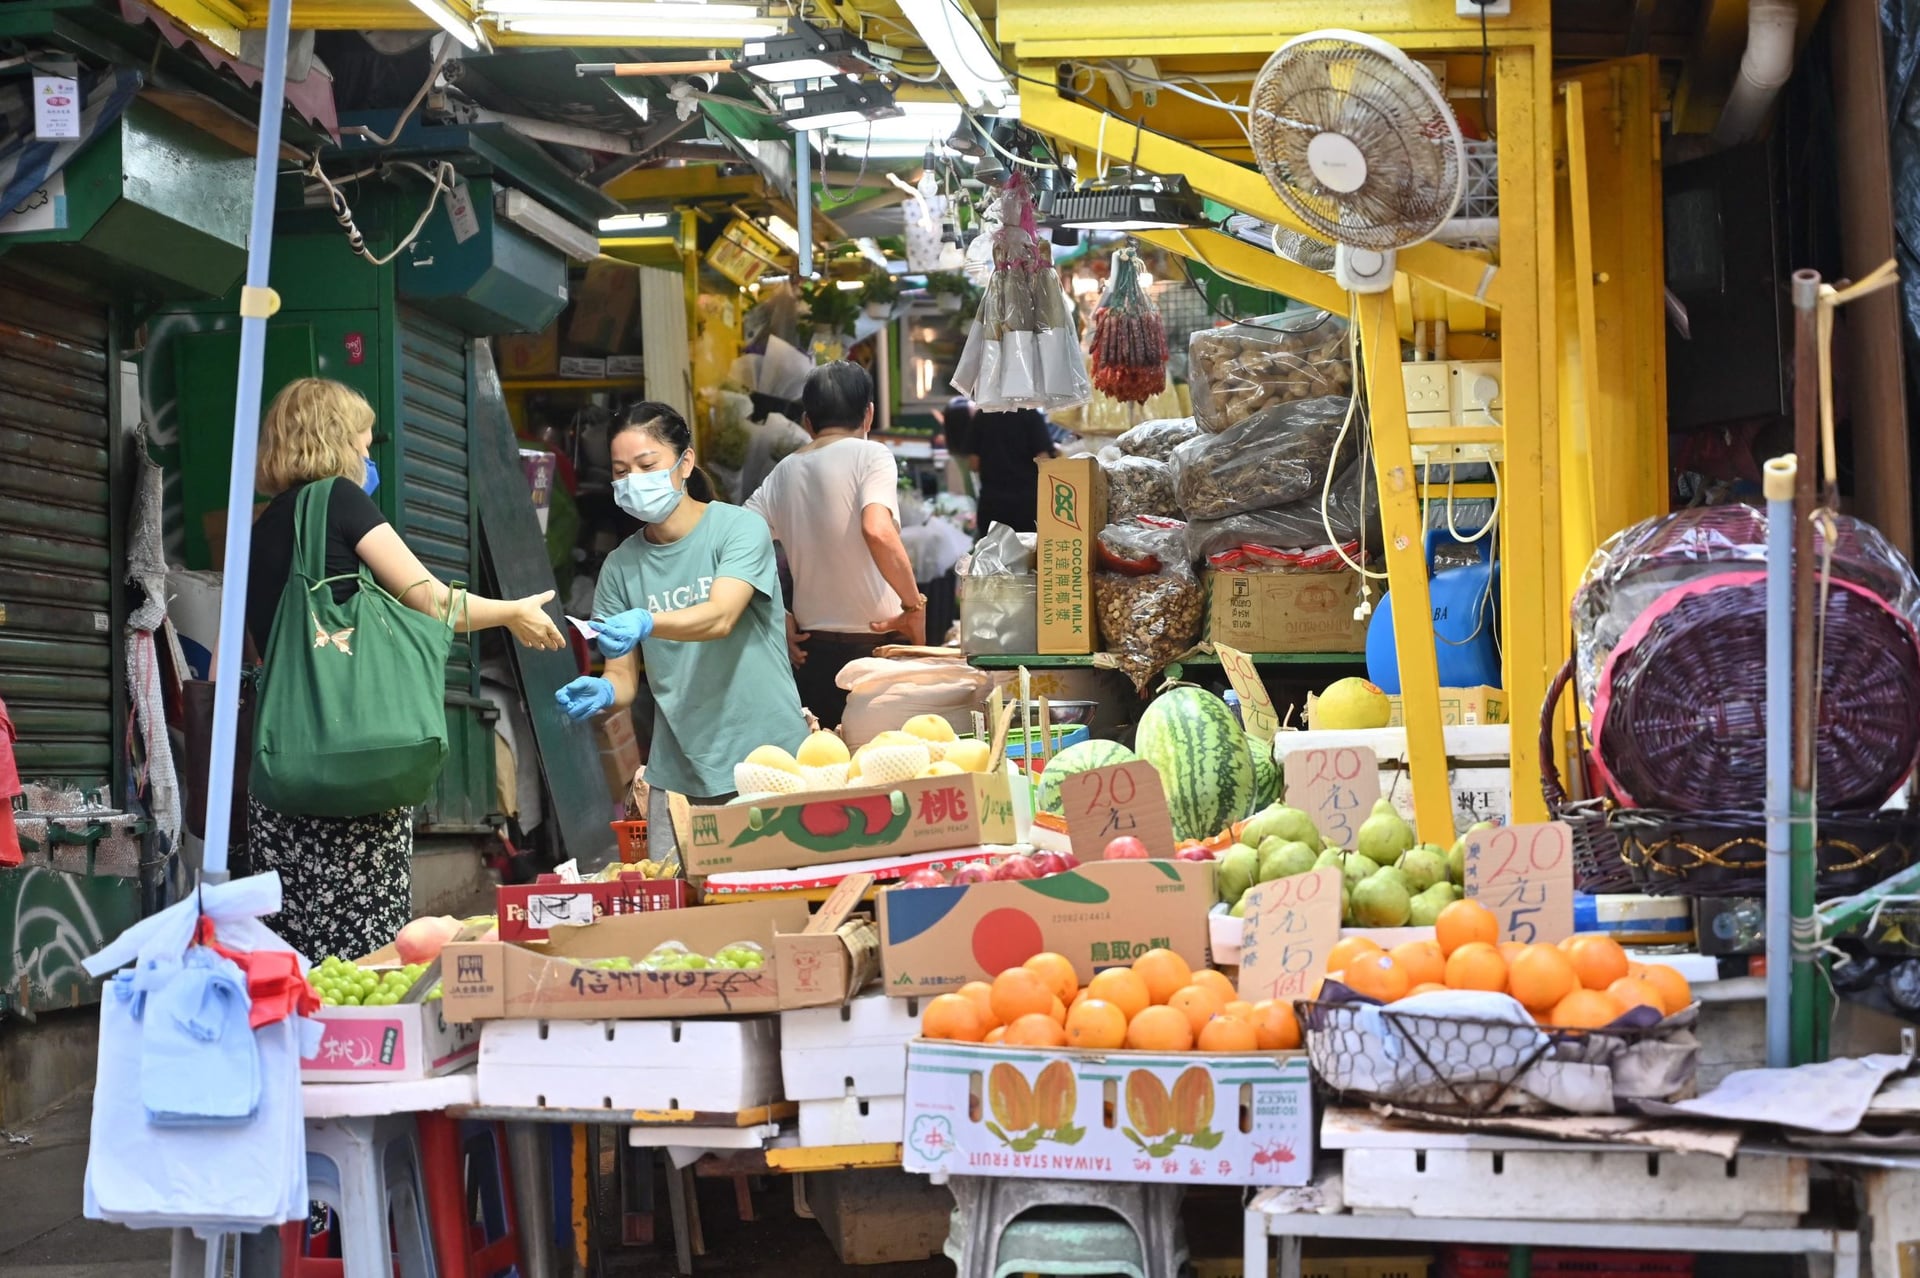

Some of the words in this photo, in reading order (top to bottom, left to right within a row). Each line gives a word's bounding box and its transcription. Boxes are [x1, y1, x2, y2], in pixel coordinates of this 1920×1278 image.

[1043, 538, 1053, 565] MADE
[1043, 567, 1053, 577] IN
[1072, 538, 1082, 600] COCONUT
[1043, 578, 1053, 626] THAILAND
[1072, 603, 1082, 634] MILK
[1305, 748, 1362, 787] 20
[917, 786, 969, 825] 桃
[1081, 766, 1136, 815] 20
[1318, 783, 1360, 811] 元
[1099, 806, 1137, 838] 元
[1326, 812, 1353, 847] 3
[1487, 825, 1564, 885] 20
[1266, 871, 1322, 915] 20
[1498, 876, 1546, 908] 元
[1270, 909, 1308, 936] 元
[1507, 906, 1542, 945] 5
[1281, 938, 1314, 974] 5
[924, 1126, 943, 1148] 中
[969, 1151, 1009, 1168] FRUIT
[1014, 1154, 1048, 1169] STAR
[1053, 1155, 1112, 1171] TAIWAN
